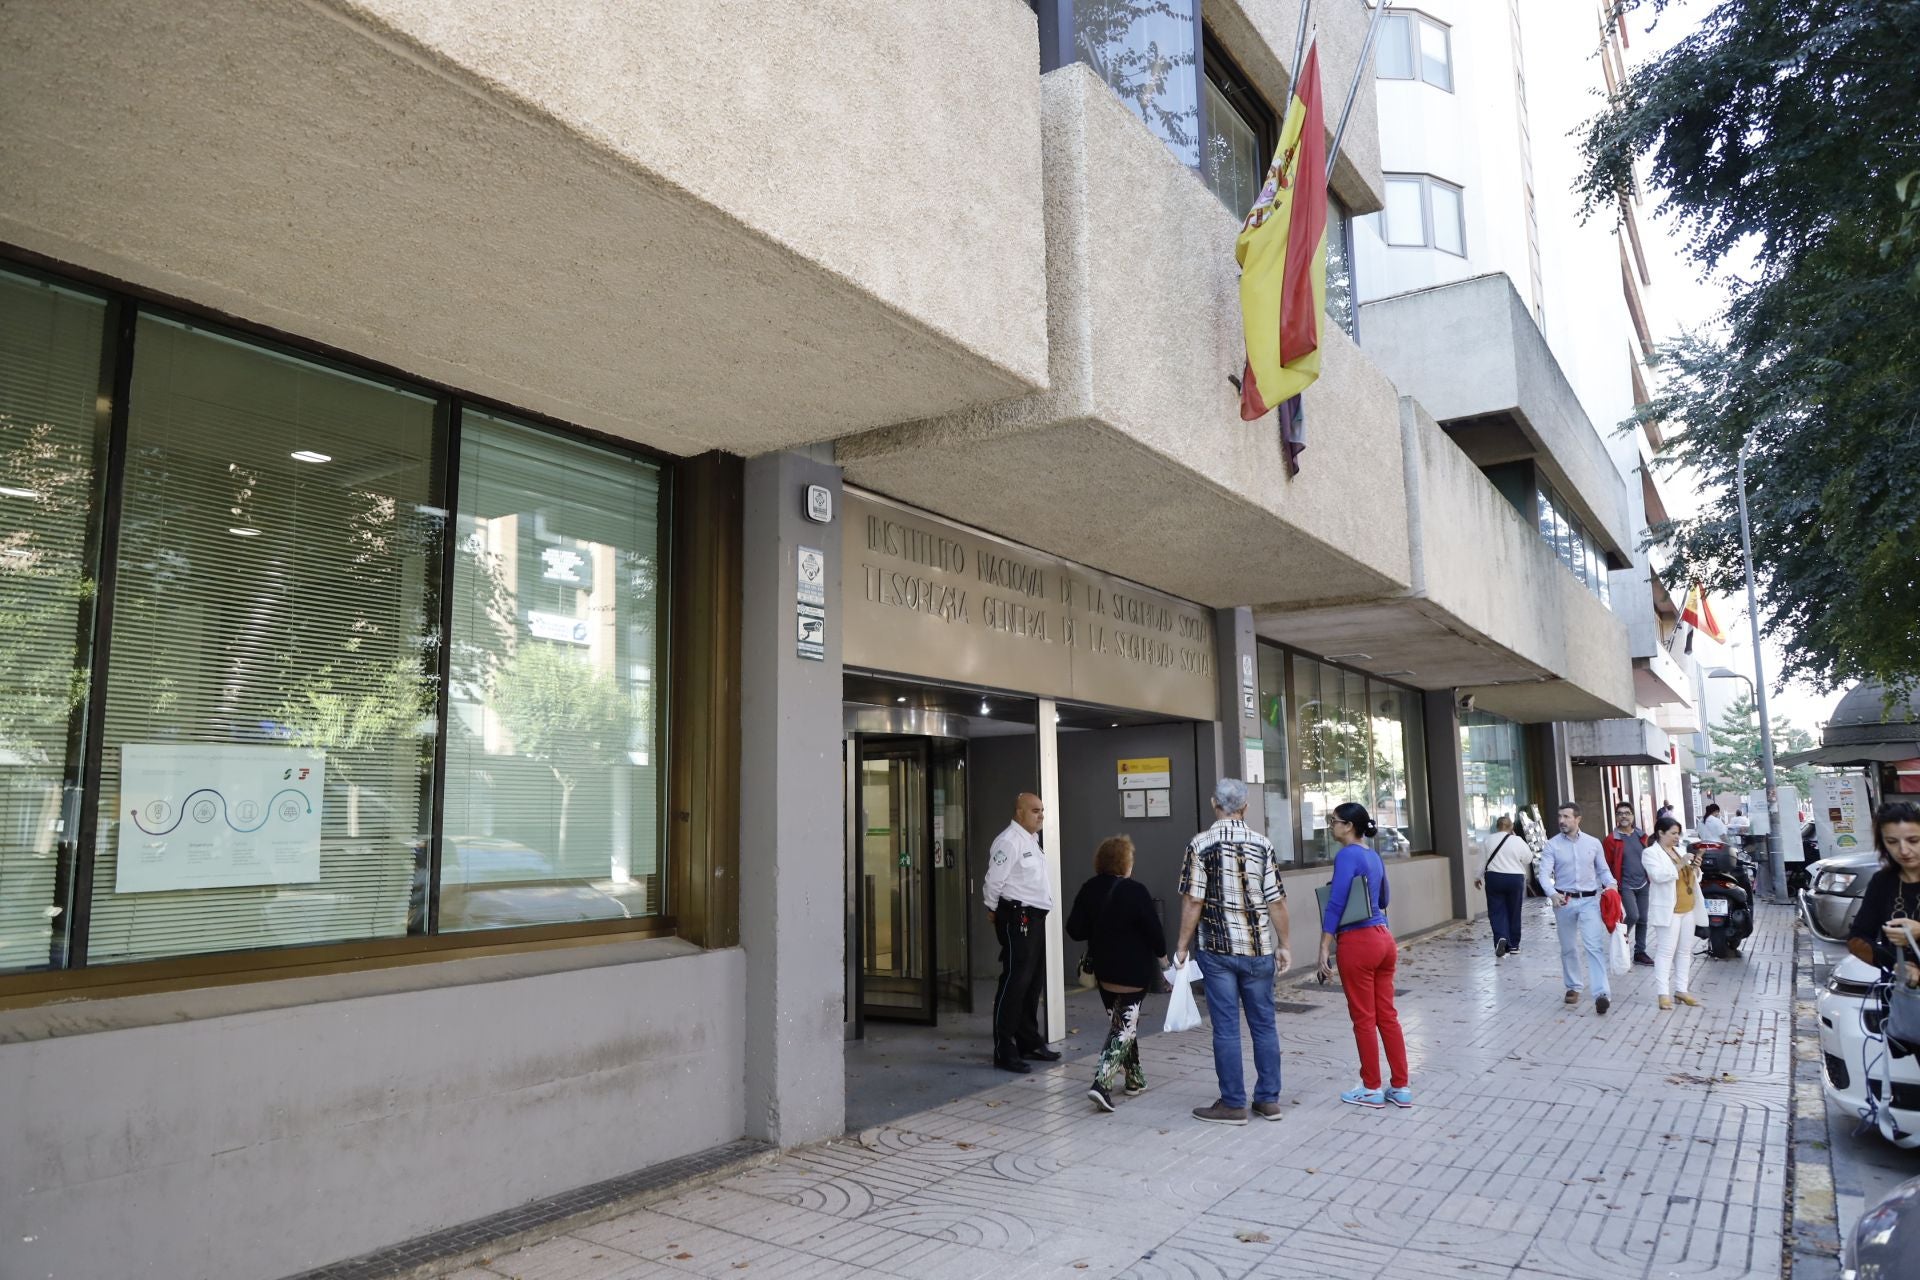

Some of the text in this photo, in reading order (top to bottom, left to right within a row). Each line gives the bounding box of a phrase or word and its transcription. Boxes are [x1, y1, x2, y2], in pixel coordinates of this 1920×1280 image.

[867, 514, 1211, 647] INSTITUTO NACIONAL DE LA SEGURIDAD SOCIAL
[982, 596, 1052, 644] GENERAL
[1062, 615, 1078, 649] DE
[1089, 623, 1107, 655] LA
[1114, 629, 1174, 669] SEGURIDAD
[1180, 646, 1213, 680] SOCIAL
